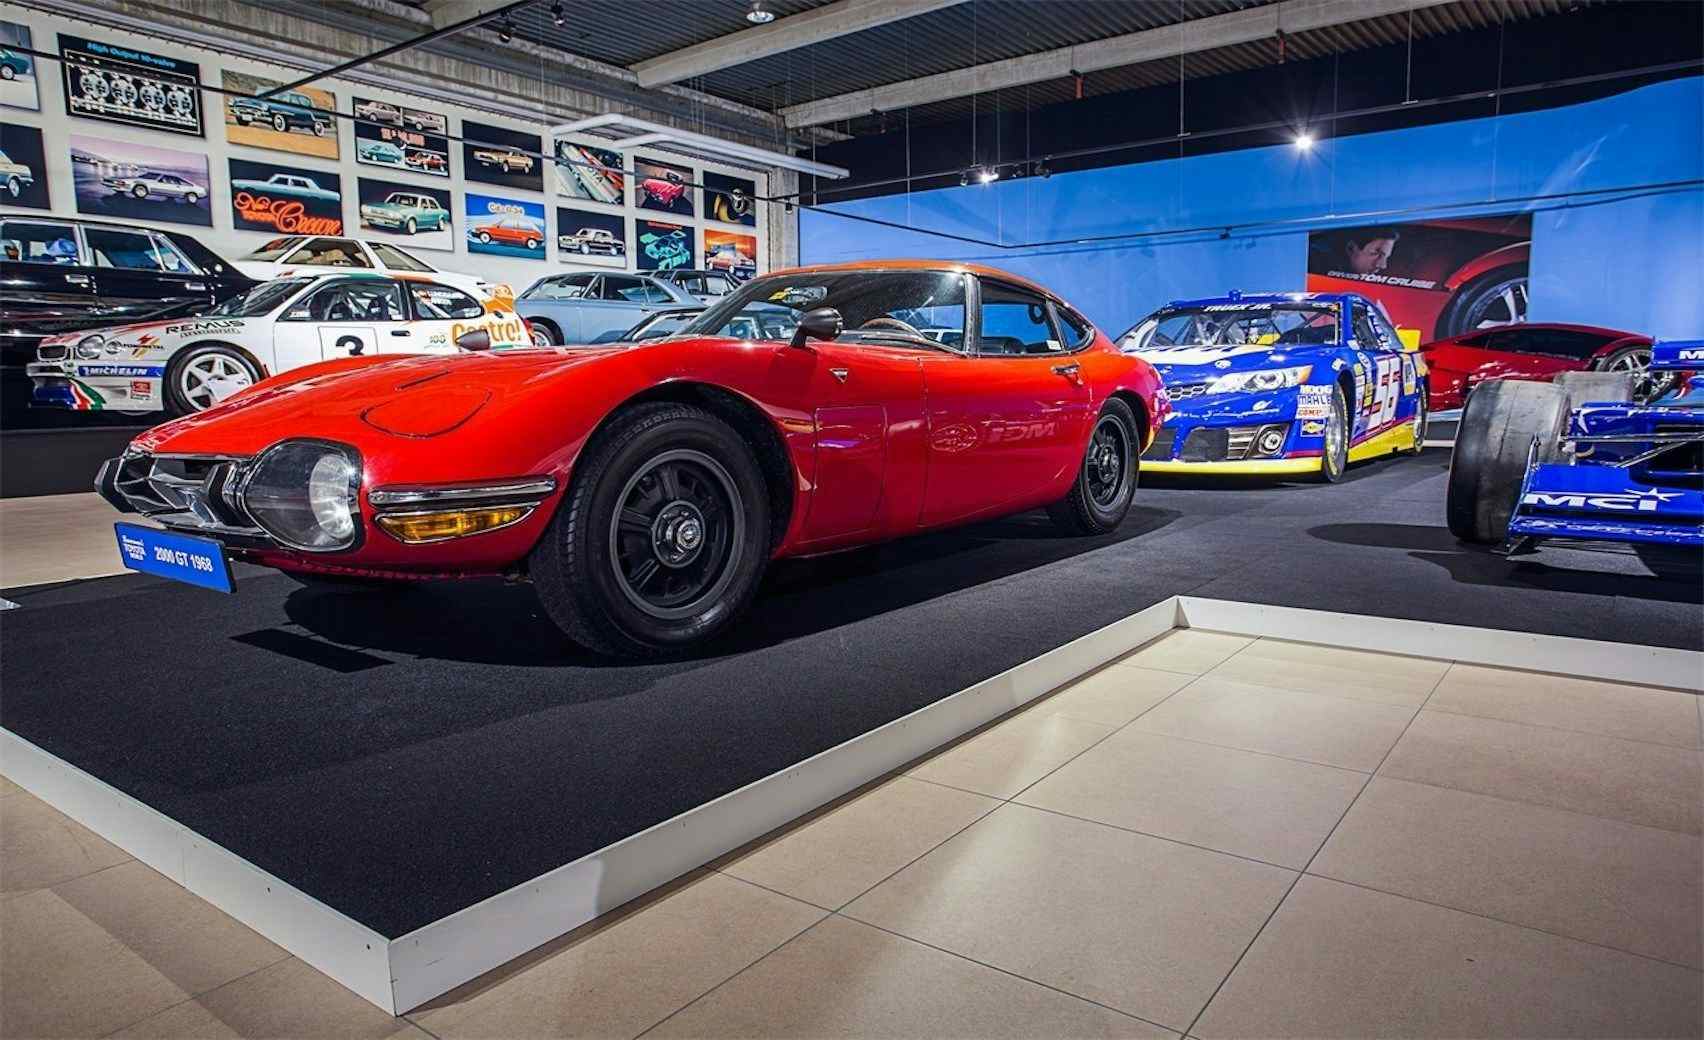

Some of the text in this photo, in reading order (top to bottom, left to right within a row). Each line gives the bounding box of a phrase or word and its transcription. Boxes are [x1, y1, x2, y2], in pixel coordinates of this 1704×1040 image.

[1359, 273, 1387, 283] TOM
[1387, 276, 1436, 289] CRUISE
[165, 320, 245, 334] REMUS
[335, 336, 364, 356] 3
[89, 366, 149, 377] MICHELIN
[154, 545, 214, 572] 2000 GT 1968
